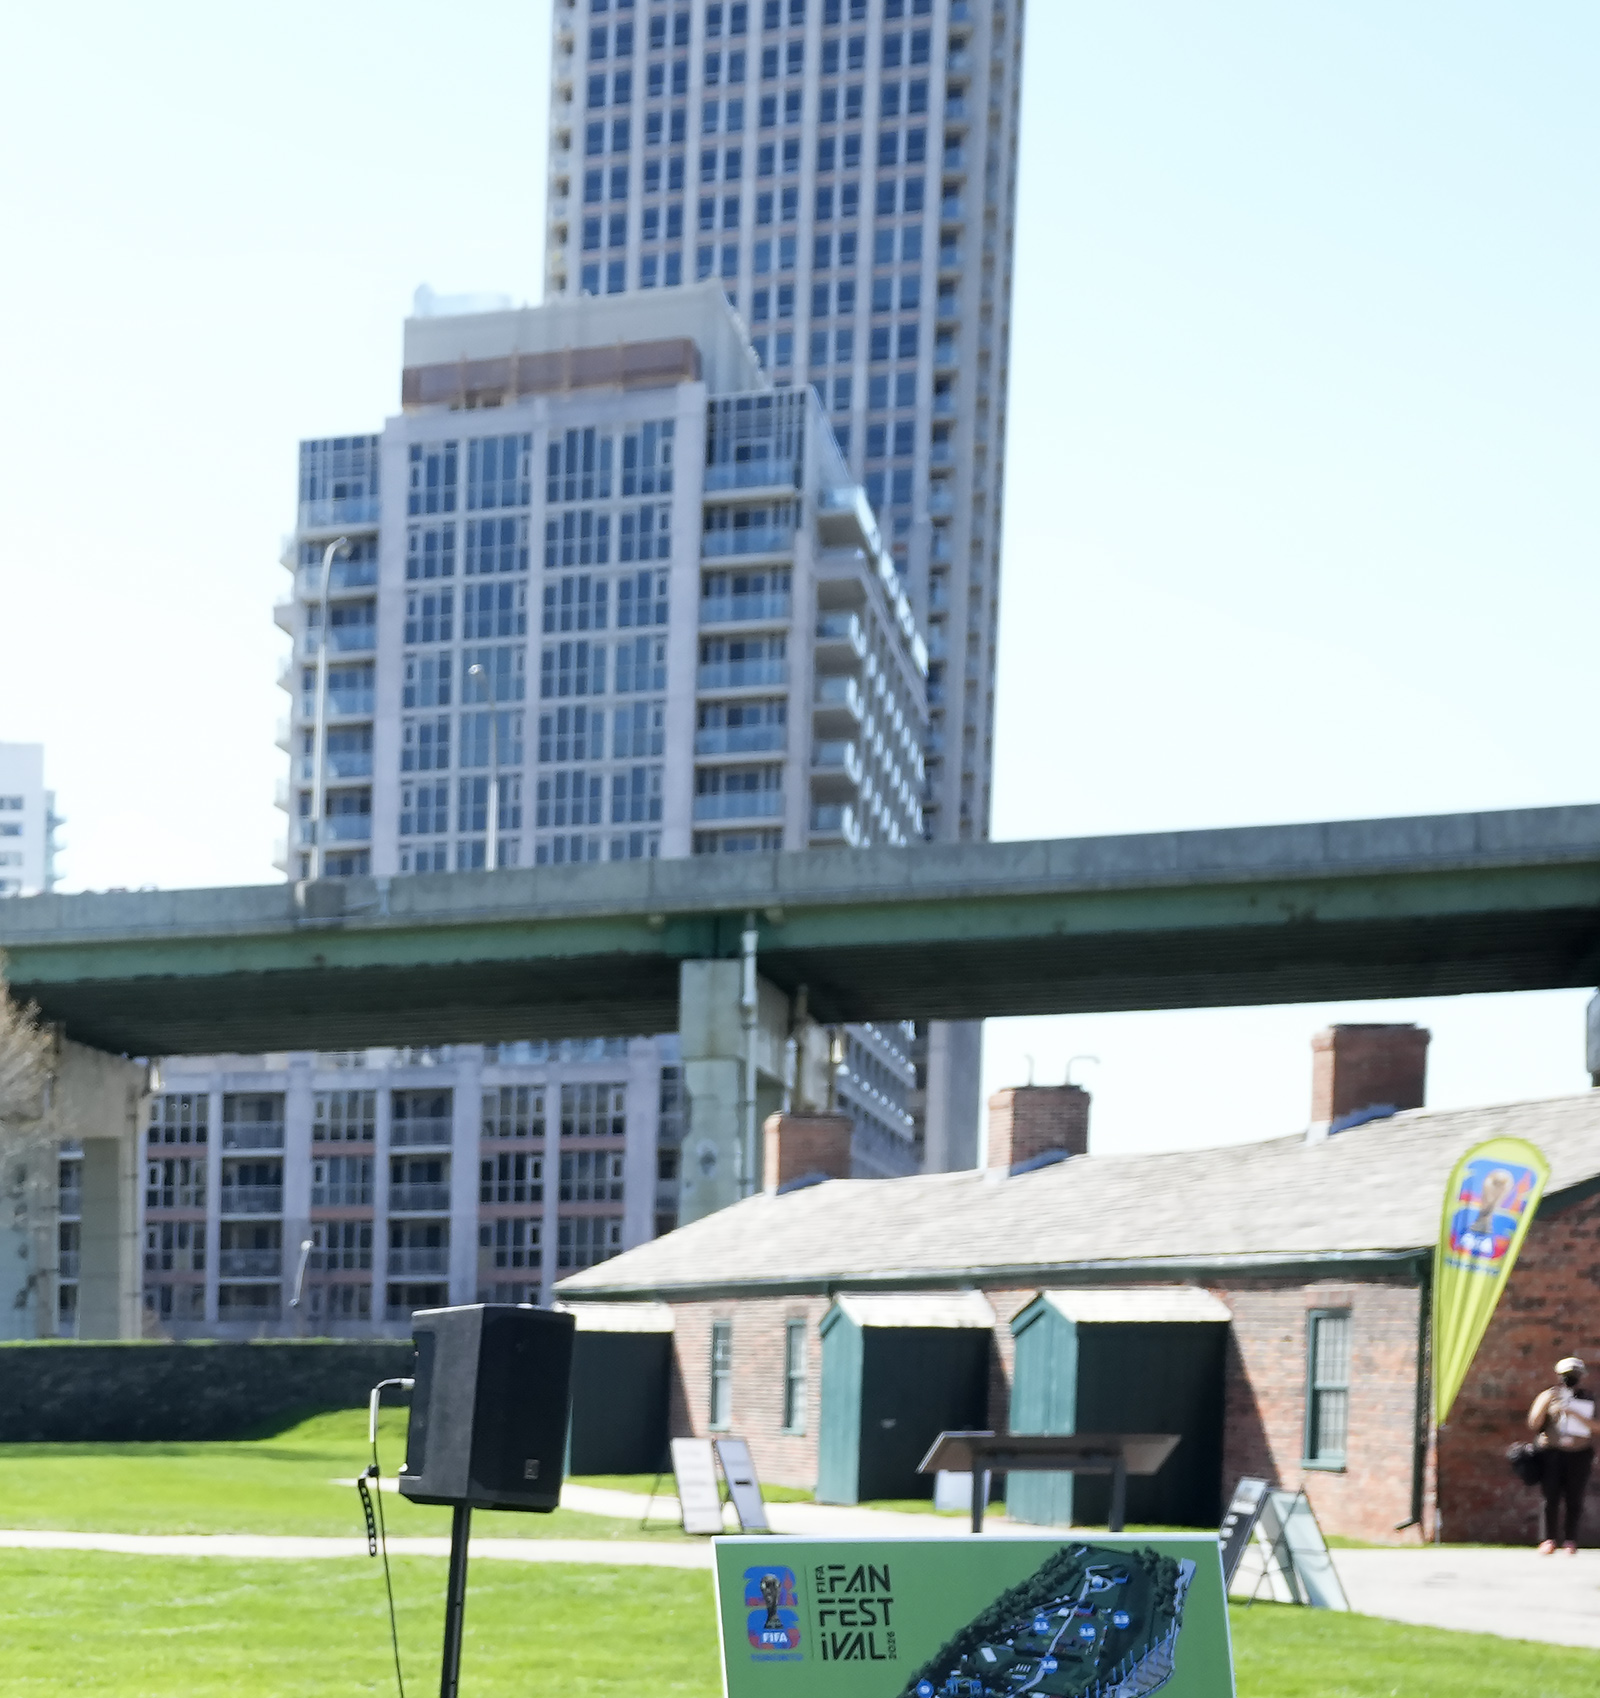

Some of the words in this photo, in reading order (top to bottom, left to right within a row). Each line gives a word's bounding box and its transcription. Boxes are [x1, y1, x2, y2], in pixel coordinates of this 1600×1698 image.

[815, 1565, 827, 1593] FIFA
[828, 1564, 891, 1593] FAN
[818, 1597, 894, 1627] FEST
[762, 1632, 788, 1643] FIFA
